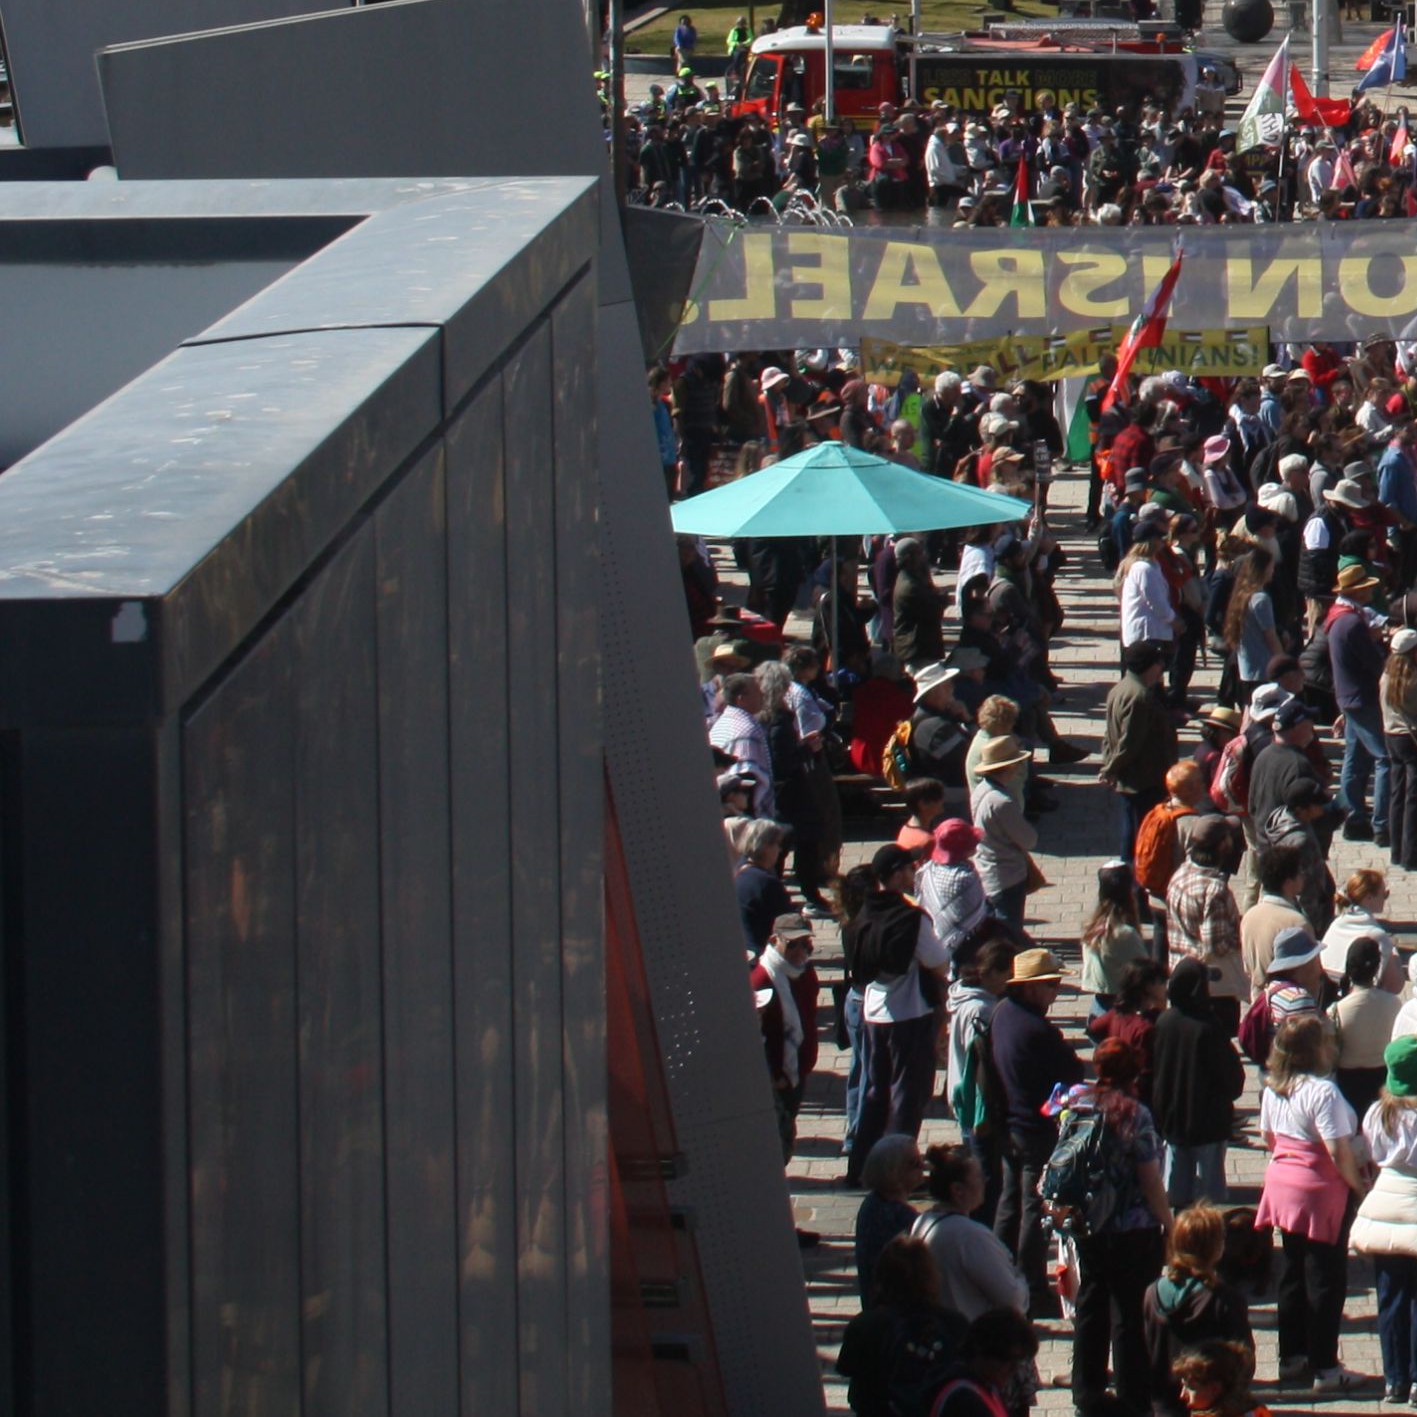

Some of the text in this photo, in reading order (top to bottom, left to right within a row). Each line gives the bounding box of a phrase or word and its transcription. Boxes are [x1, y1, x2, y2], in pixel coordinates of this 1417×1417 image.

[923, 69, 1097, 87] LESS TALK MORE
[1042, 344, 1258, 373] PALEINIANS!
